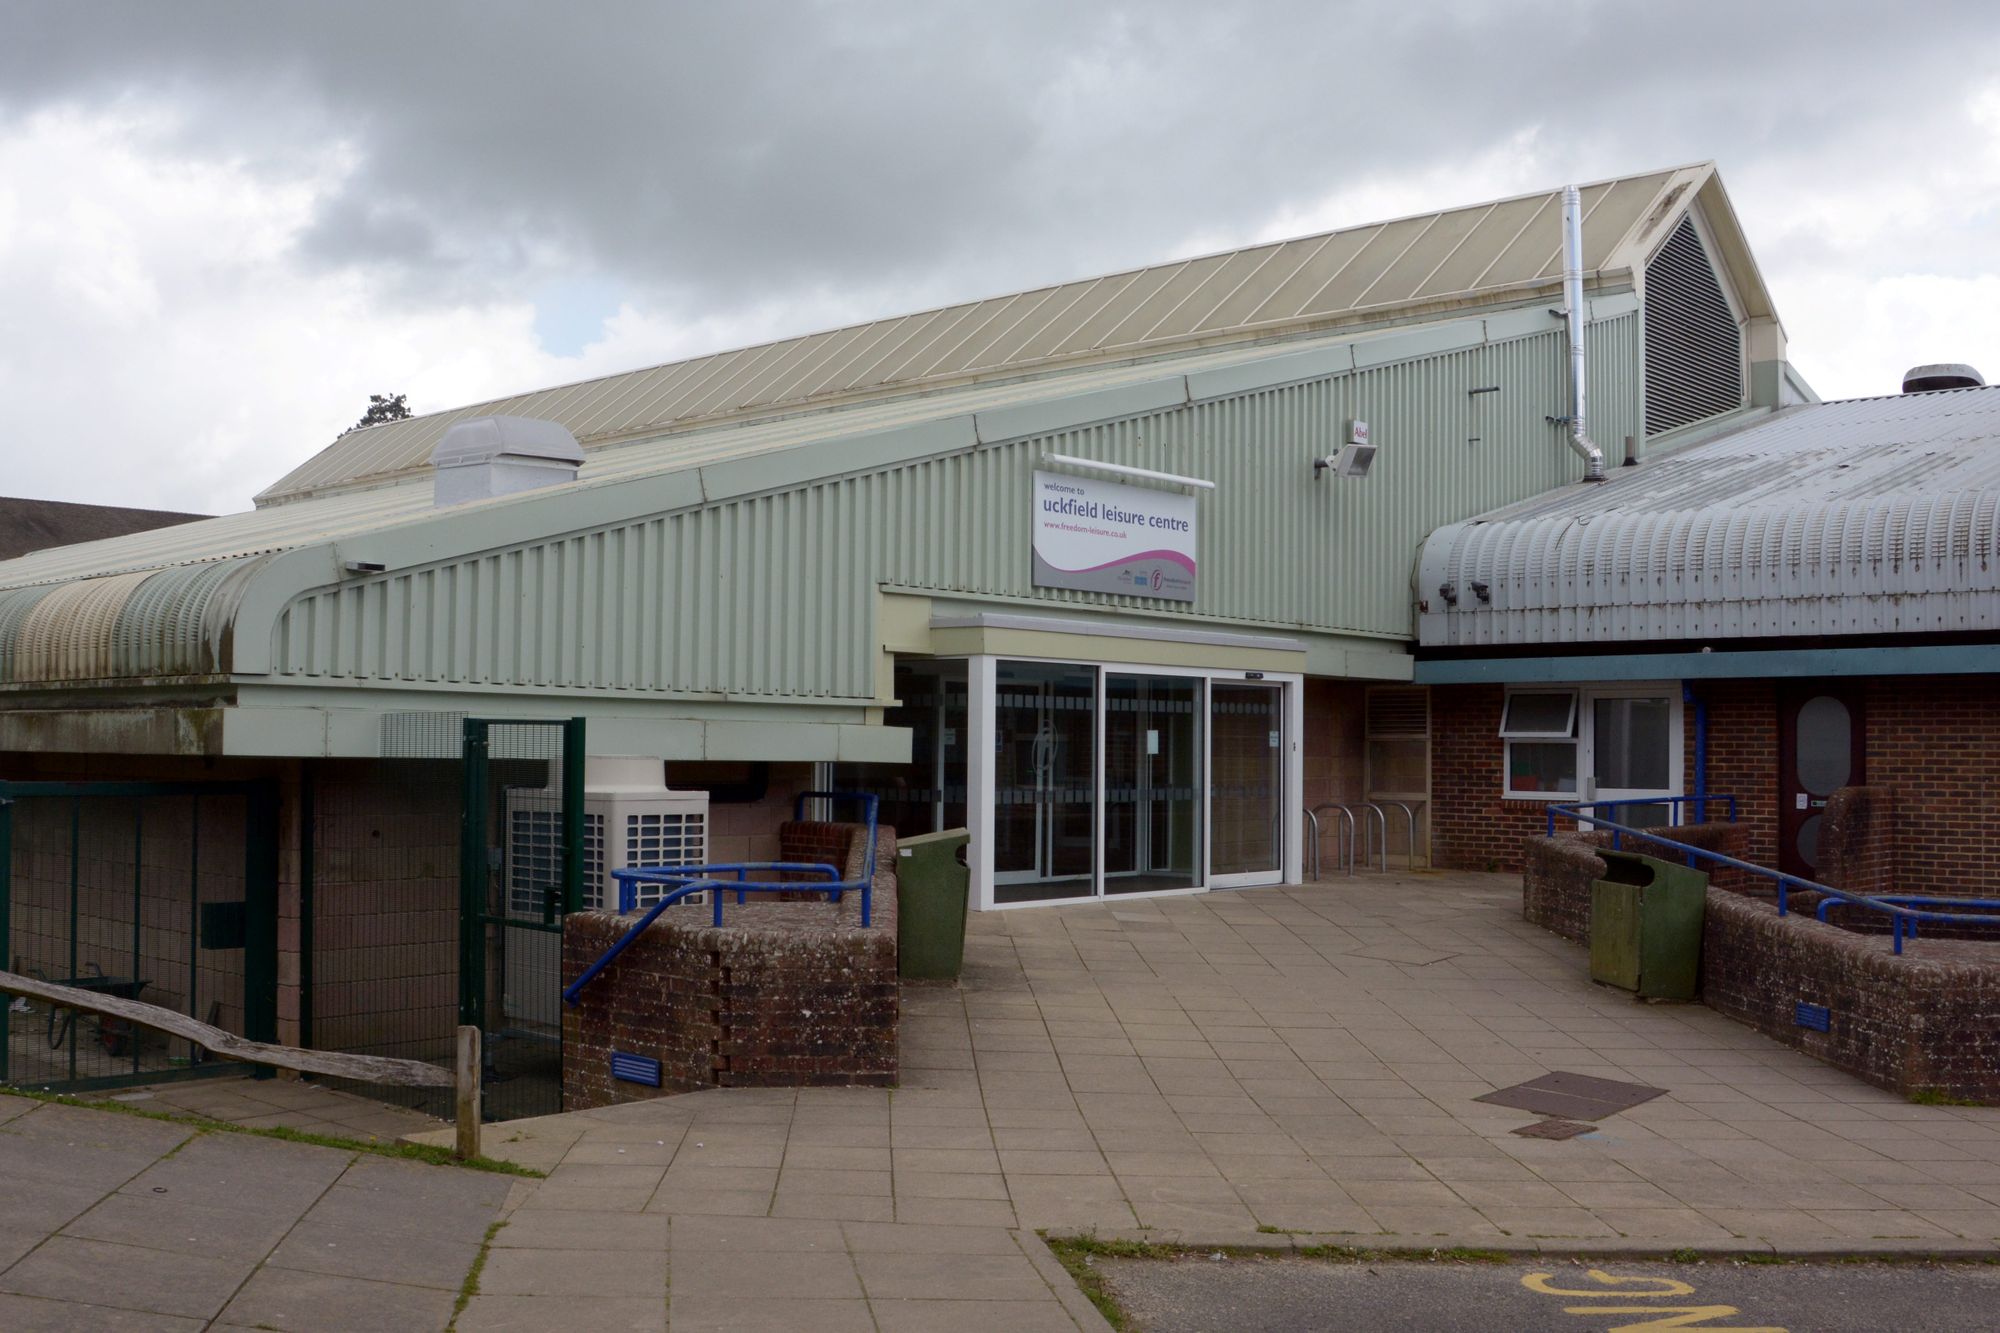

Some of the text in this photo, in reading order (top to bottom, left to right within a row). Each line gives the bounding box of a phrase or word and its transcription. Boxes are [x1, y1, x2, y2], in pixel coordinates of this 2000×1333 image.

[1044, 482, 1085, 496] welcome to
[1043, 497, 1189, 532] uckfield leisure centre
[1044, 520, 1127, 539] www.freedom-leisure.co.uk
